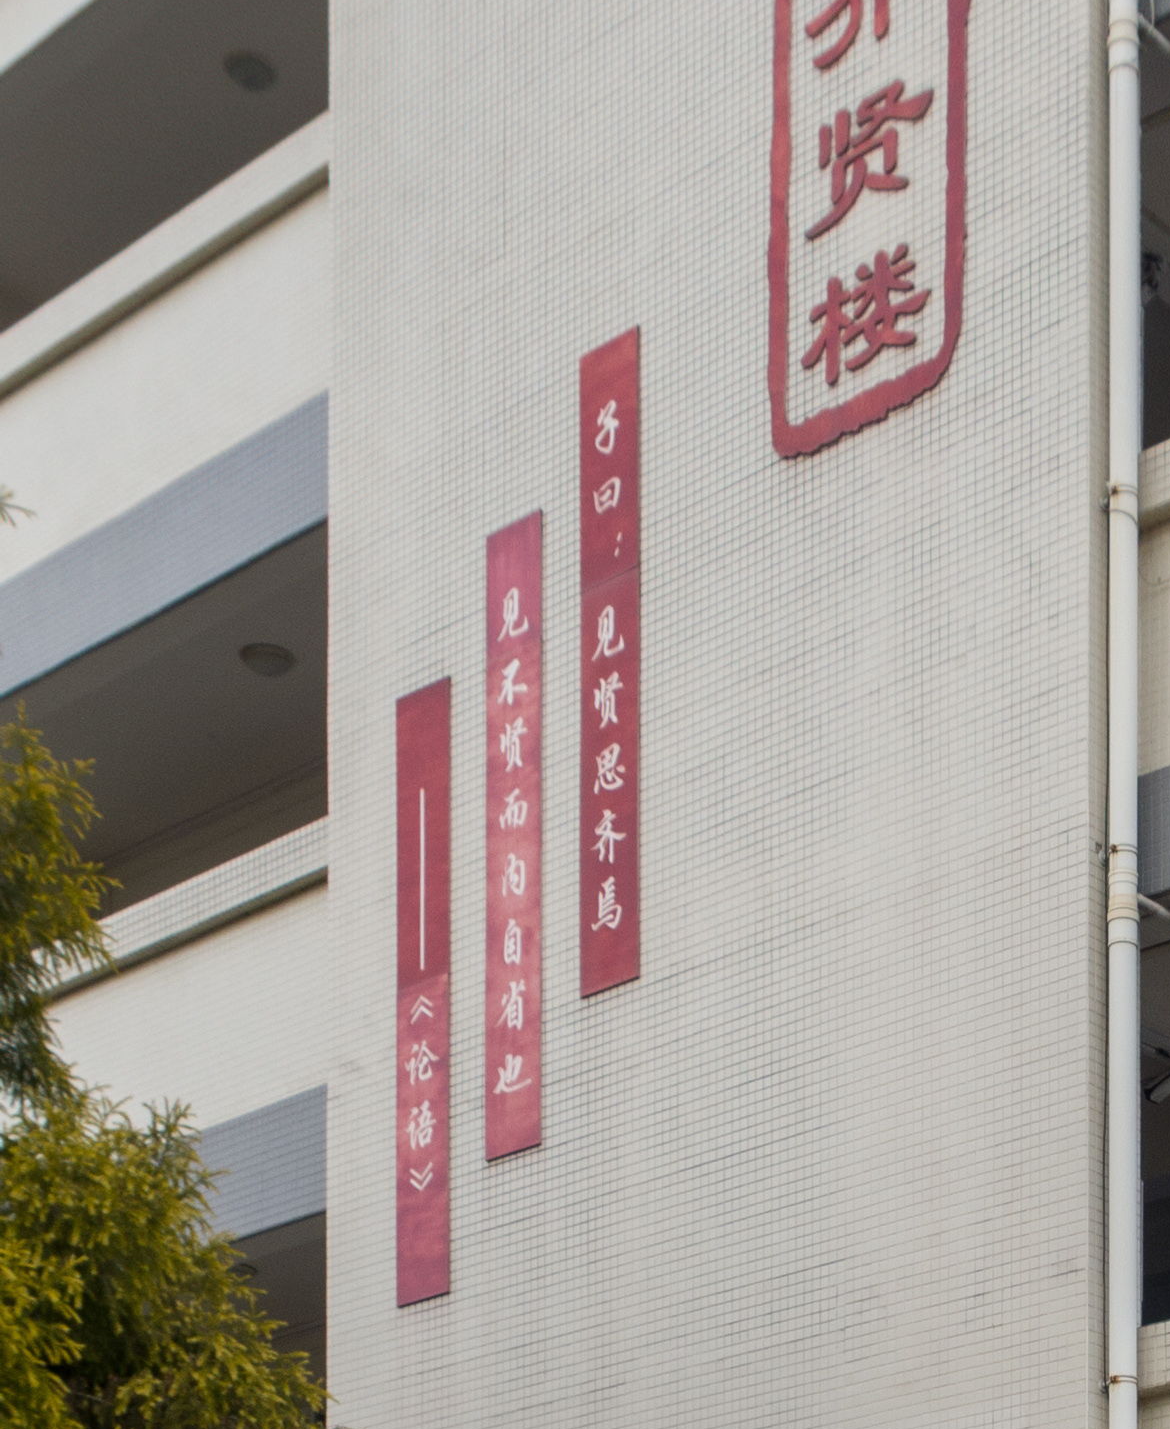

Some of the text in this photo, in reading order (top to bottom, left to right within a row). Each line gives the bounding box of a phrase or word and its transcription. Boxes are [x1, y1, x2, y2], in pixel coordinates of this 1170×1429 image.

[491, 586, 533, 1095] 见不贤而内自省也
